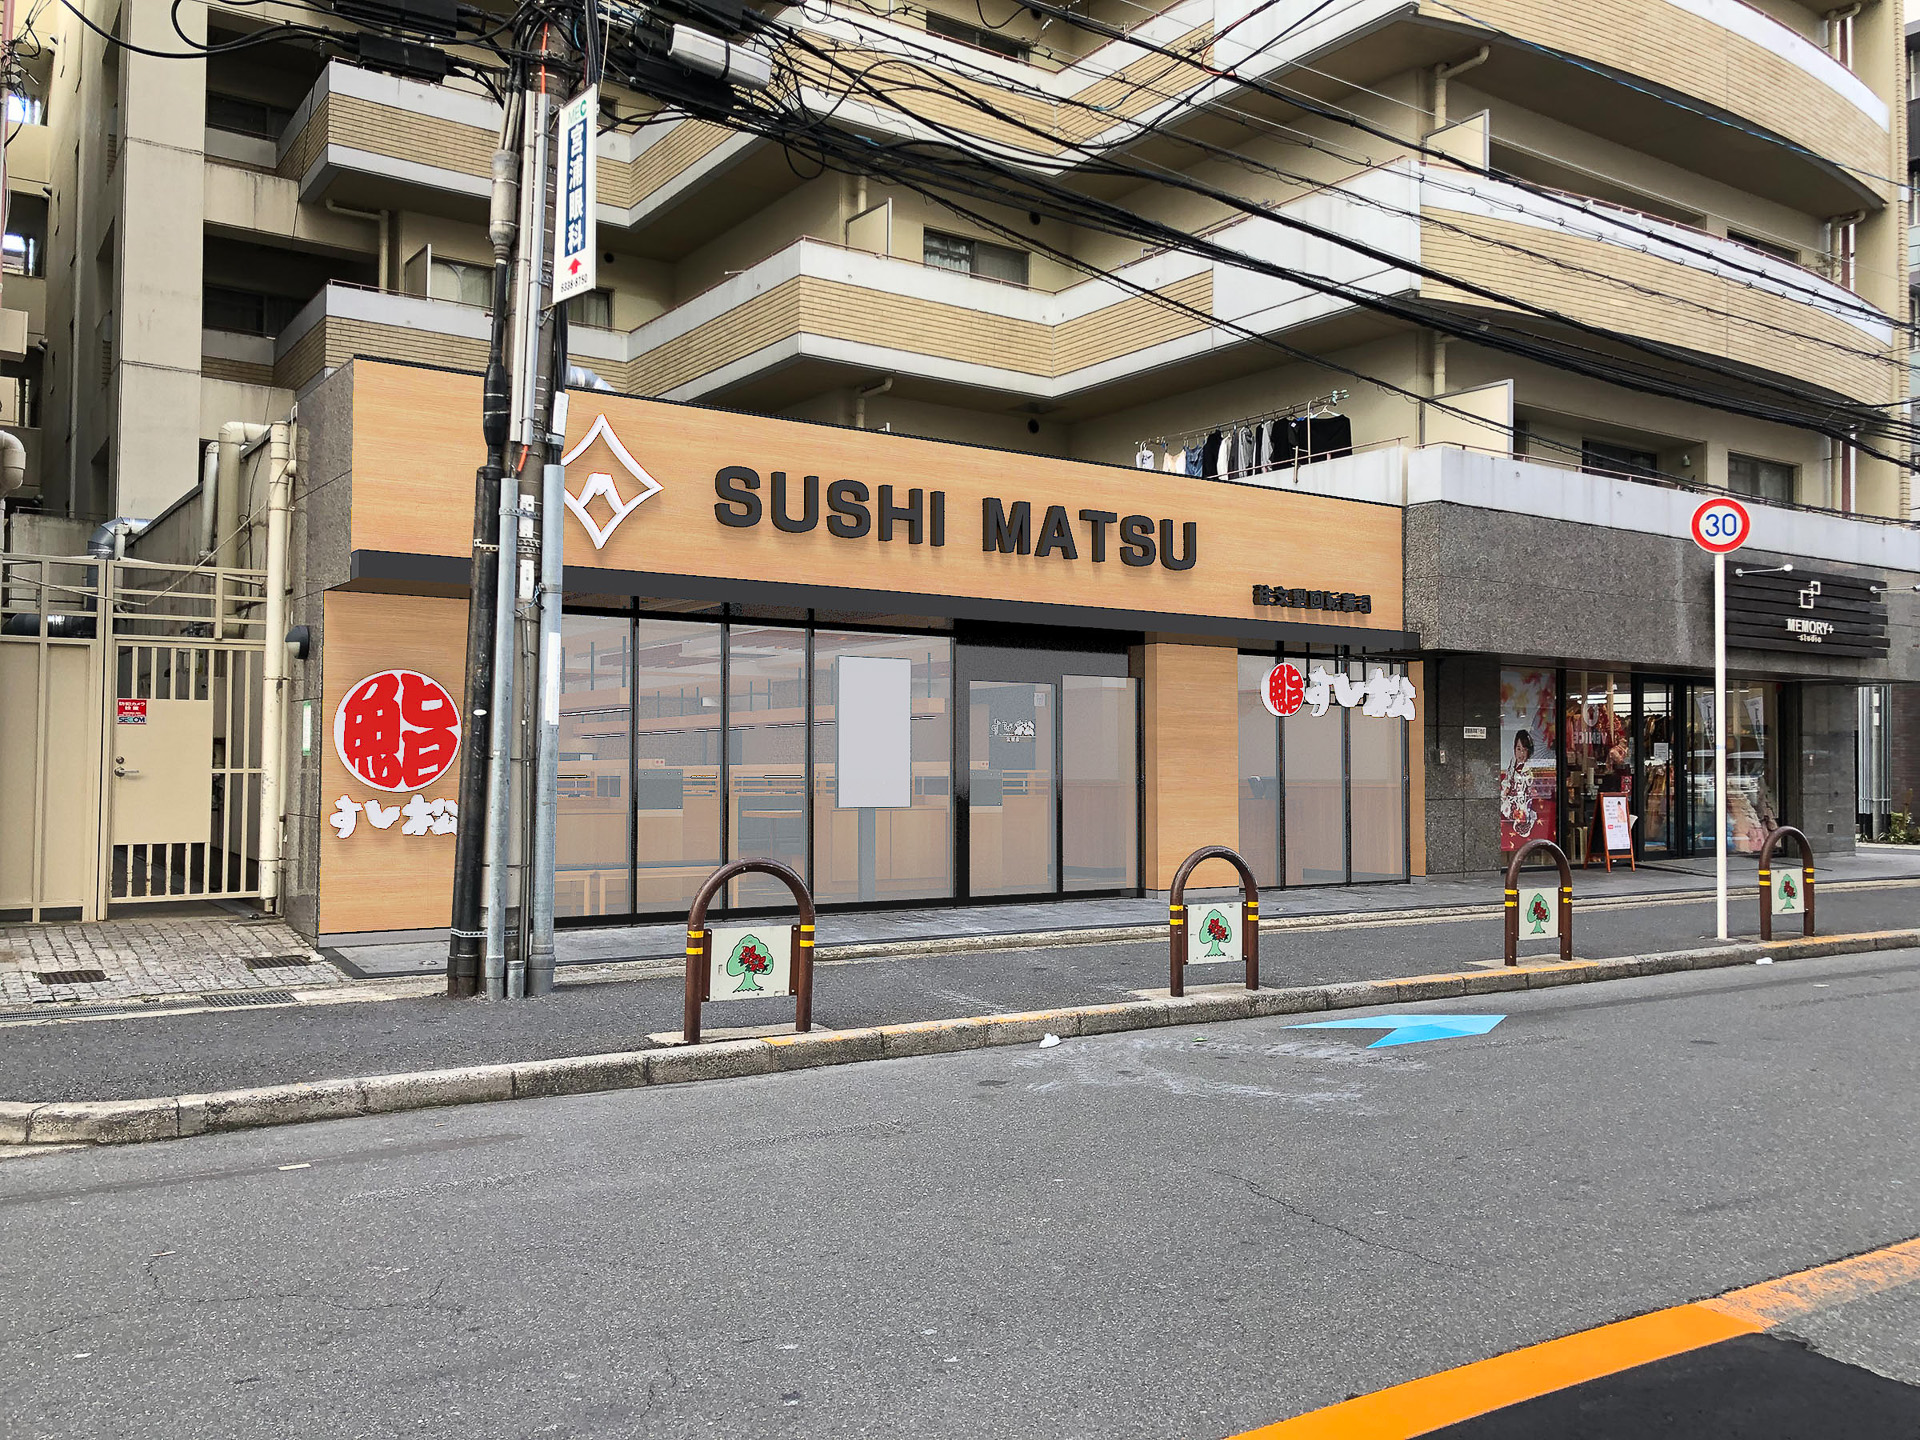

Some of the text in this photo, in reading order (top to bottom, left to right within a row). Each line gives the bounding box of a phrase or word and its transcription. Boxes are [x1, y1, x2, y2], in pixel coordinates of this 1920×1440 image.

[568, 99, 587, 124] MEC
[567, 123, 584, 253] 宮浦眼科
[714, 465, 1197, 572] SUSHI MATSU
[1705, 513, 1737, 537] 30
[343, 672, 459, 789] 鮨
